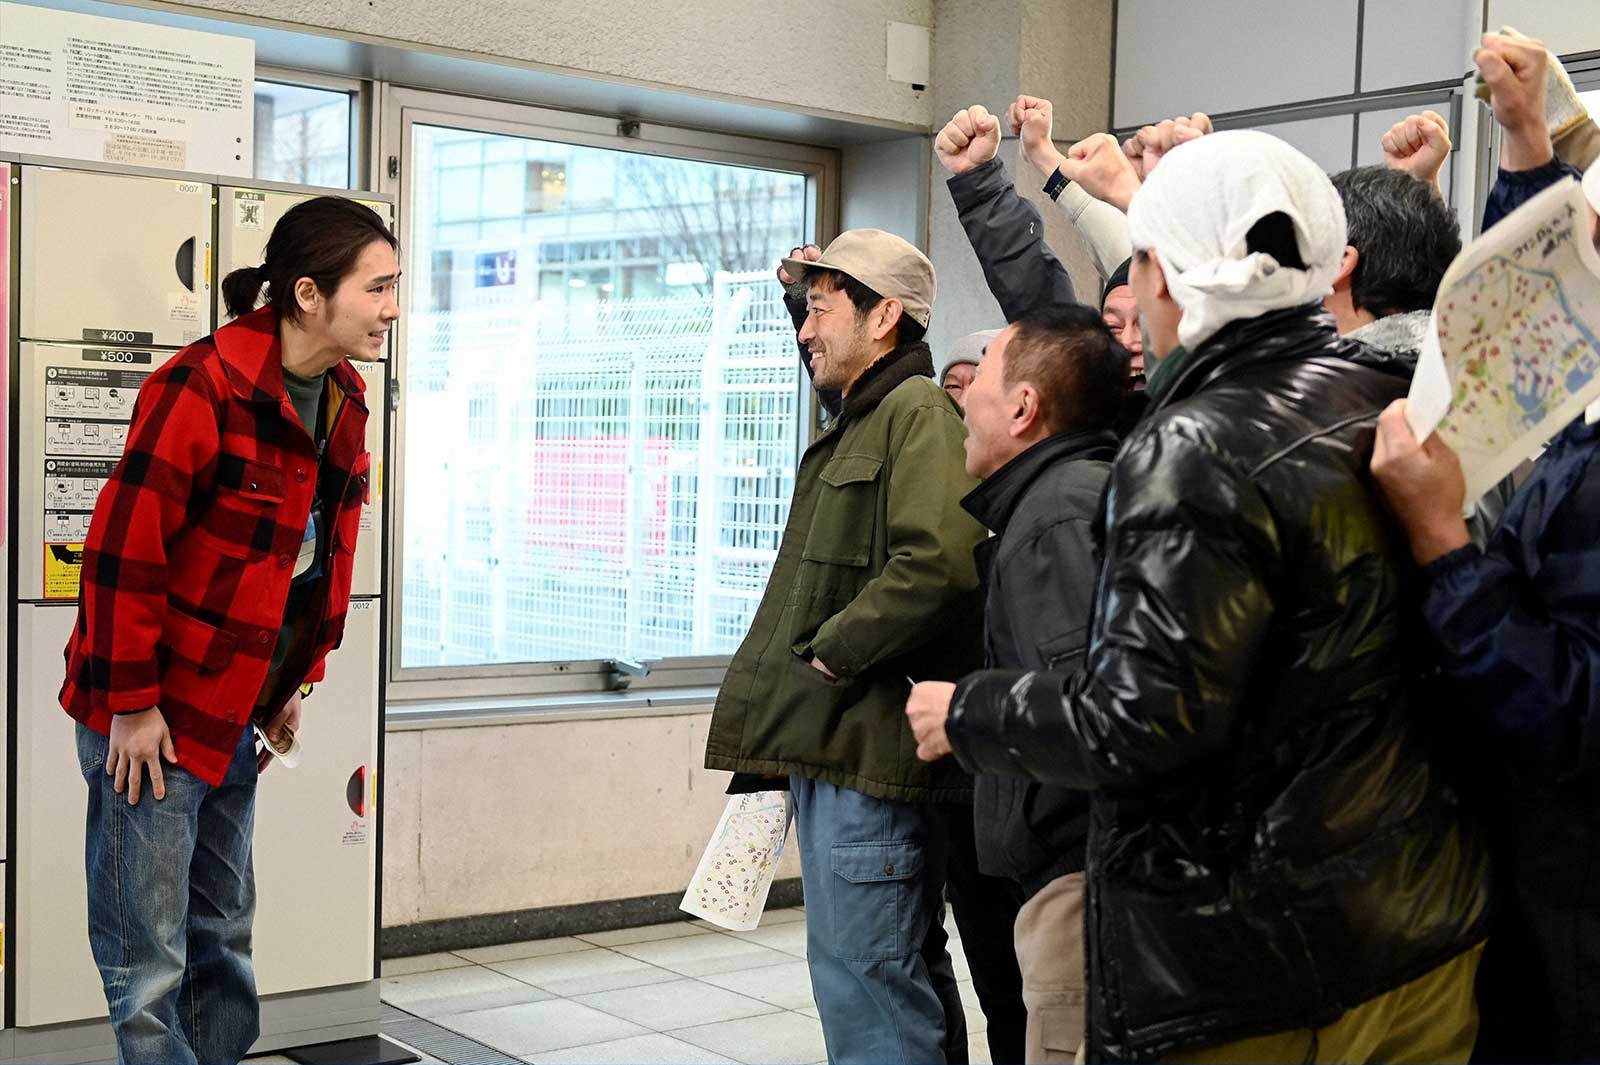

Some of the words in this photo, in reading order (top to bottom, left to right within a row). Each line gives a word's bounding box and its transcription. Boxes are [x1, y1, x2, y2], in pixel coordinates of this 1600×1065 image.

[179, 184, 199, 193] 0007
[102, 330, 135, 342] ¥400
[100, 351, 134, 362] ¥500
[356, 364, 373, 372] 0011
[352, 602, 370, 610] 0012
